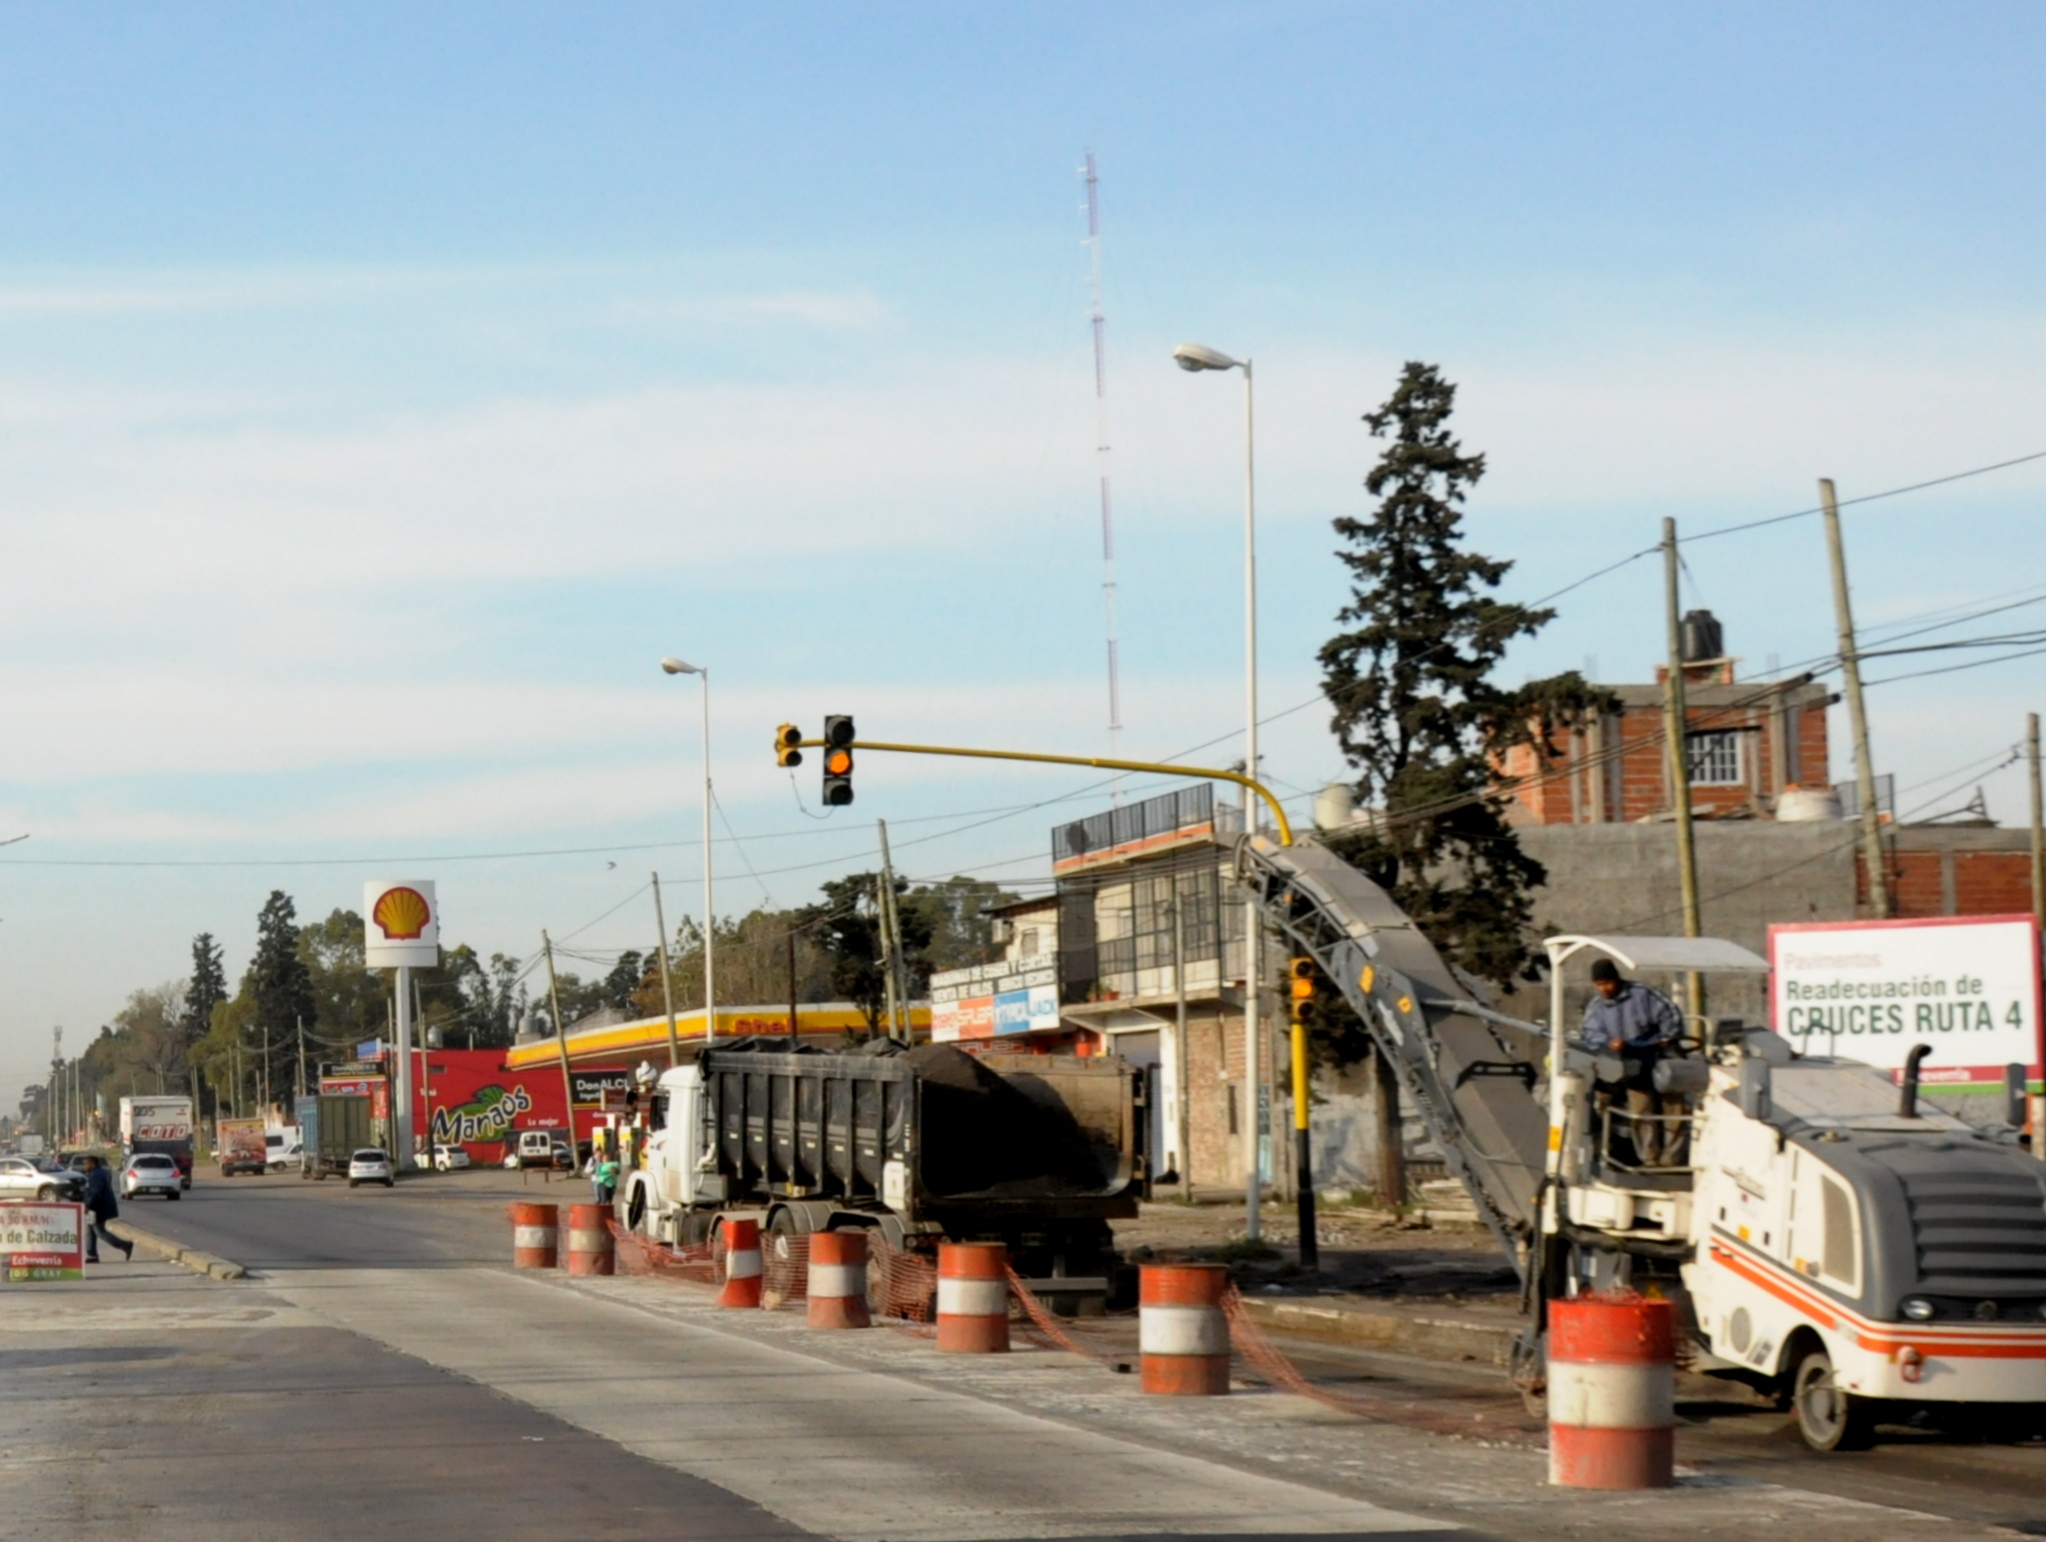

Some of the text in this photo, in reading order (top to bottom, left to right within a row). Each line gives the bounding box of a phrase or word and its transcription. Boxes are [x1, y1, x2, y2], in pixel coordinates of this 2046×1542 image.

[1786, 975, 1983, 1000] Readecuación de
[734, 1018, 800, 1034] Shel
[1788, 1000, 2023, 1036] CRUCES RUTA 4
[432, 1085, 532, 1145] Manaos
[137, 1123, 189, 1140] COTO
[7, 1230, 23, 1243] de
[27, 1230, 77, 1244] Calzada
